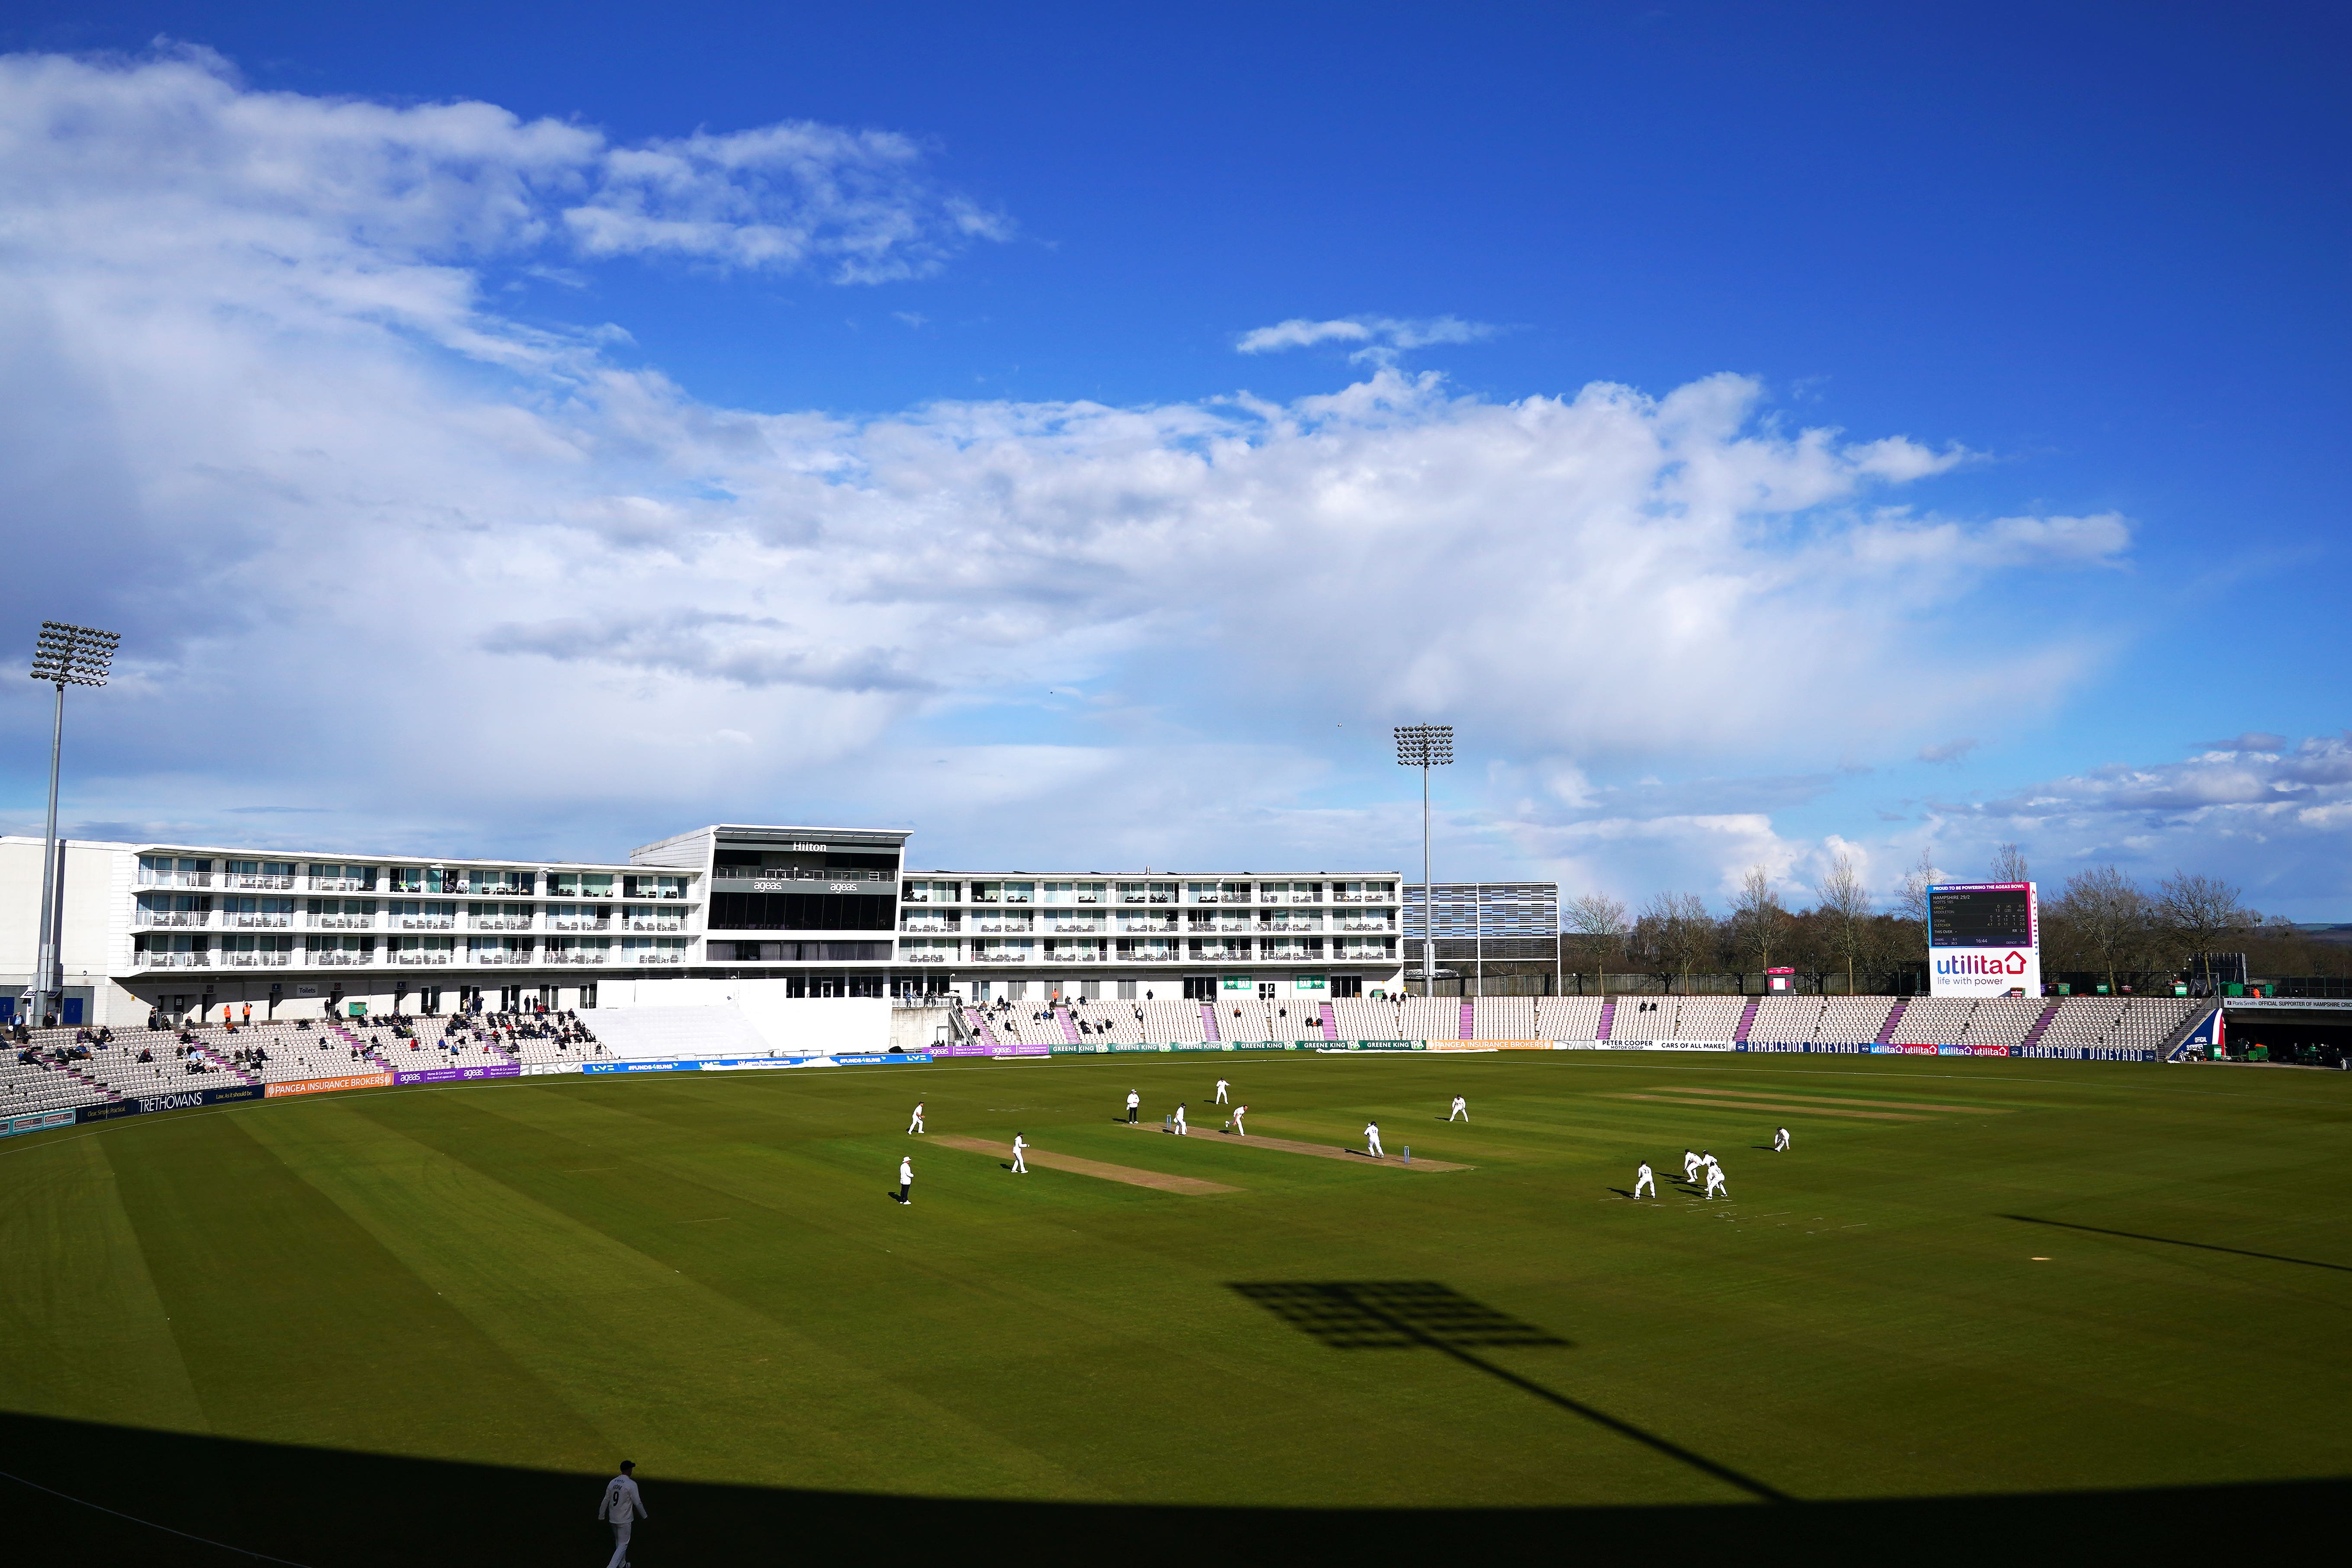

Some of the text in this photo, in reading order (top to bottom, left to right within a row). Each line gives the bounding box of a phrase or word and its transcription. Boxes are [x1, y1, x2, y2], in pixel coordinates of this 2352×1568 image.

[793, 842, 827, 852] Hilton
[1937, 955, 2003, 974] utilita
[1237, 980, 1250, 989] BAR
[1096, 1043, 1109, 1052] IPA
[1159, 1042, 1172, 1052] IPA
[1221, 1042, 1234, 1051] IPA
[1284, 1041, 1297, 1050] IPA
[1347, 1040, 1360, 1049] IPA
[1411, 1040, 1424, 1049] IPA
[1748, 1041, 1859, 1053] HAMBLEDON VINEYARD
[1871, 1045, 1896, 1054] utilita
[1905, 1046, 1929, 1054] utilita
[1940, 1047, 1964, 1055] utilita
[1974, 1047, 1999, 1056] utilita
[2022, 1046, 2143, 1061] HAMBLEDON VINEYARD
[275, 1076, 384, 1094] PANGEA INSURANCE BROKERS
[139, 1092, 202, 1113] TRETHOWANS
[613, 1491, 619, 1507] 9
